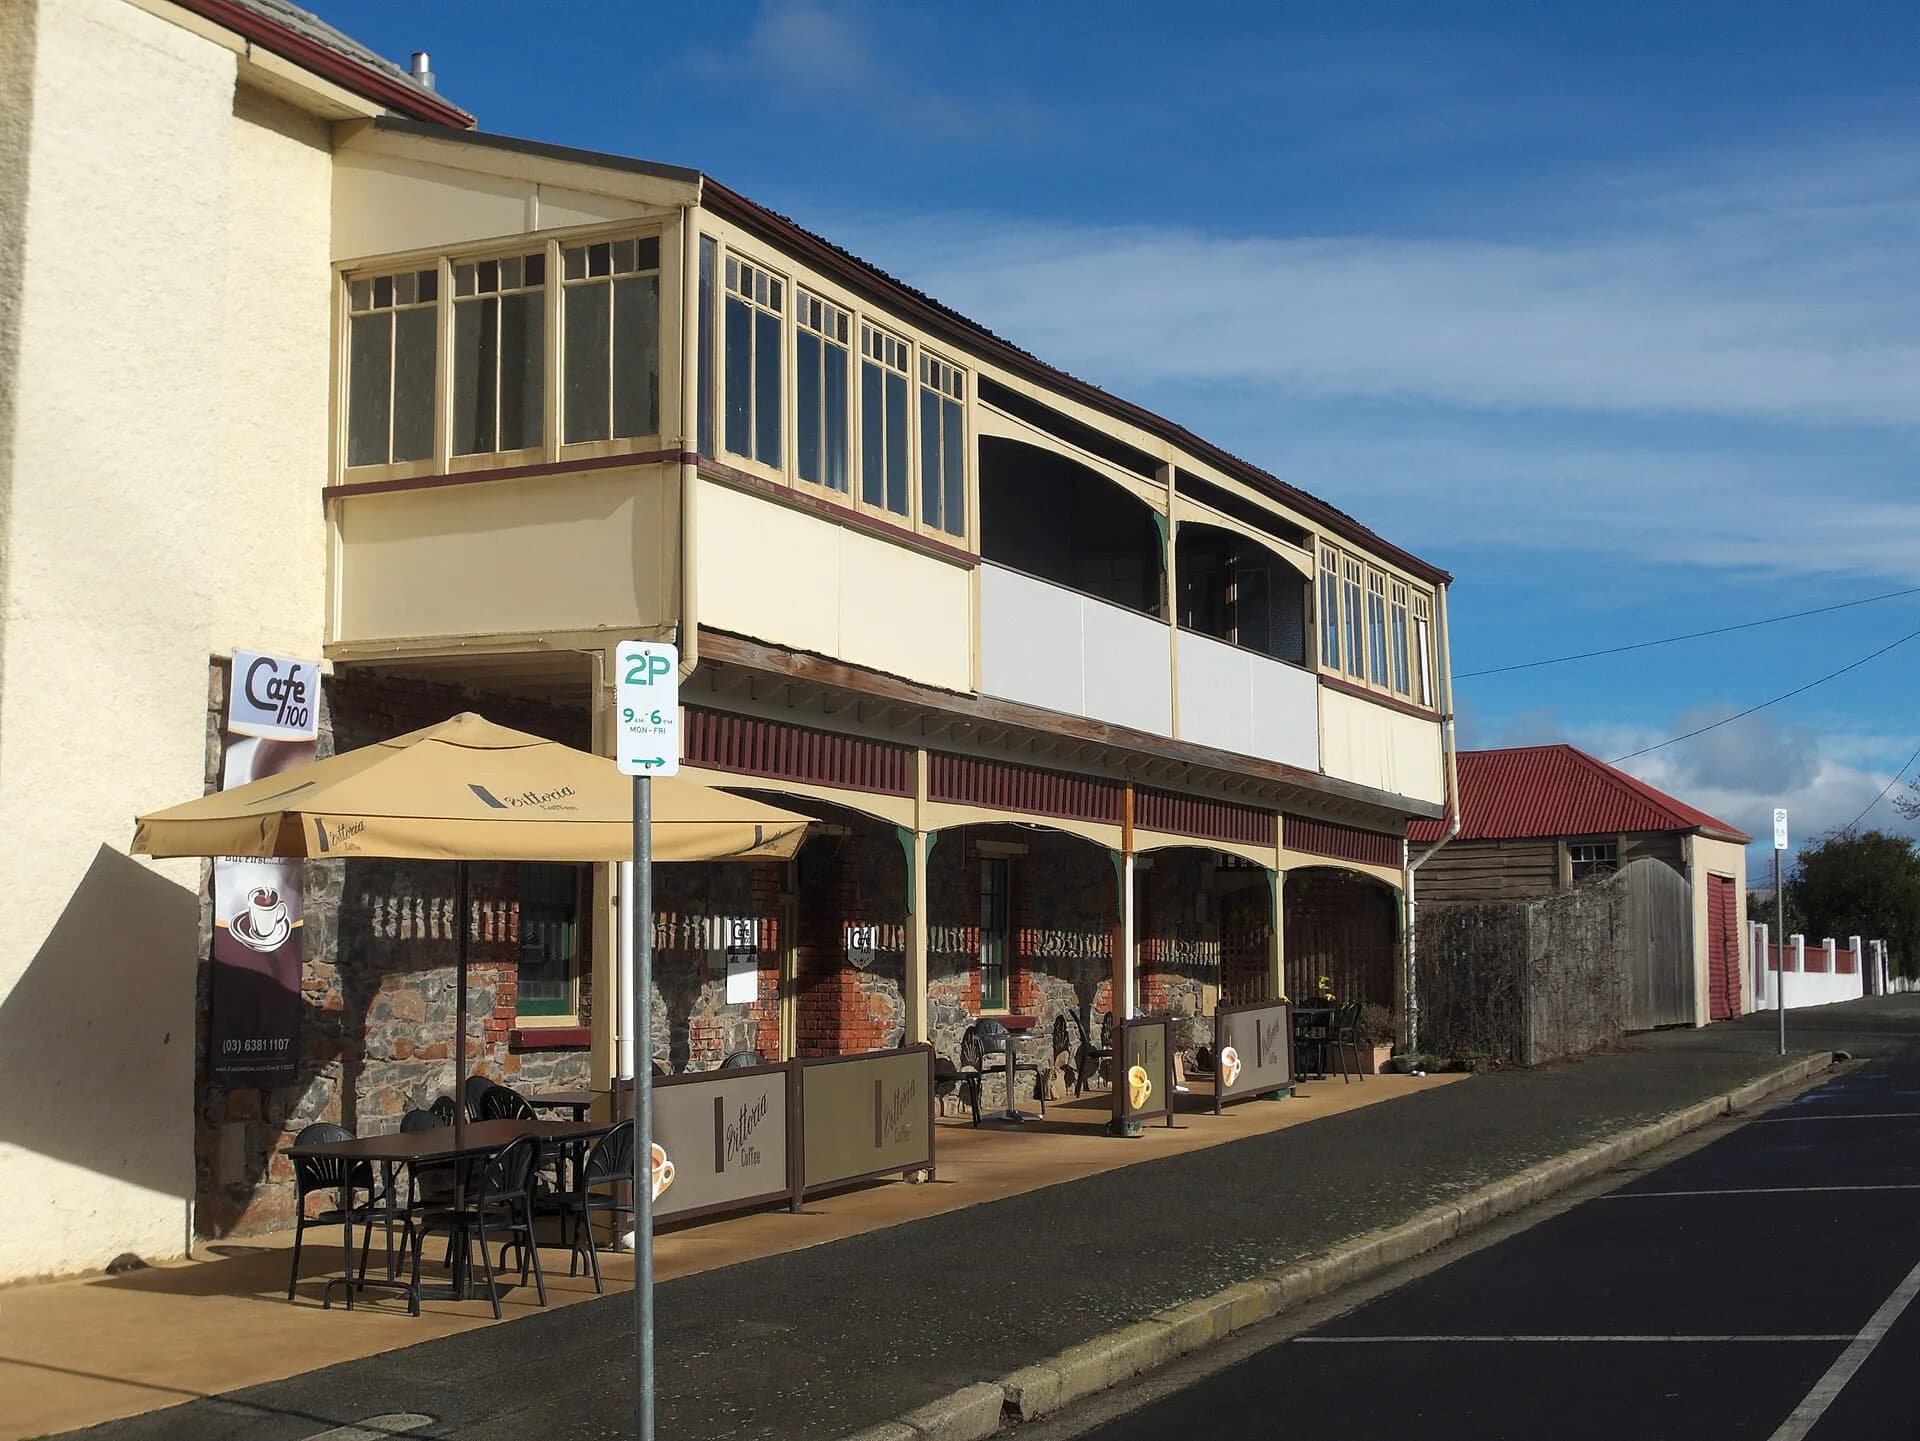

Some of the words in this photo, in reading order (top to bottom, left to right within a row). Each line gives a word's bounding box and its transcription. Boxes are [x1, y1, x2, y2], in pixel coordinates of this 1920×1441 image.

[625, 654, 670, 686] 2P
[245, 656, 306, 724] Cafe
[285, 705, 308, 728] 100
[222, 1039, 242, 1054] (03)
[741, 1147, 761, 1168] Coffee
